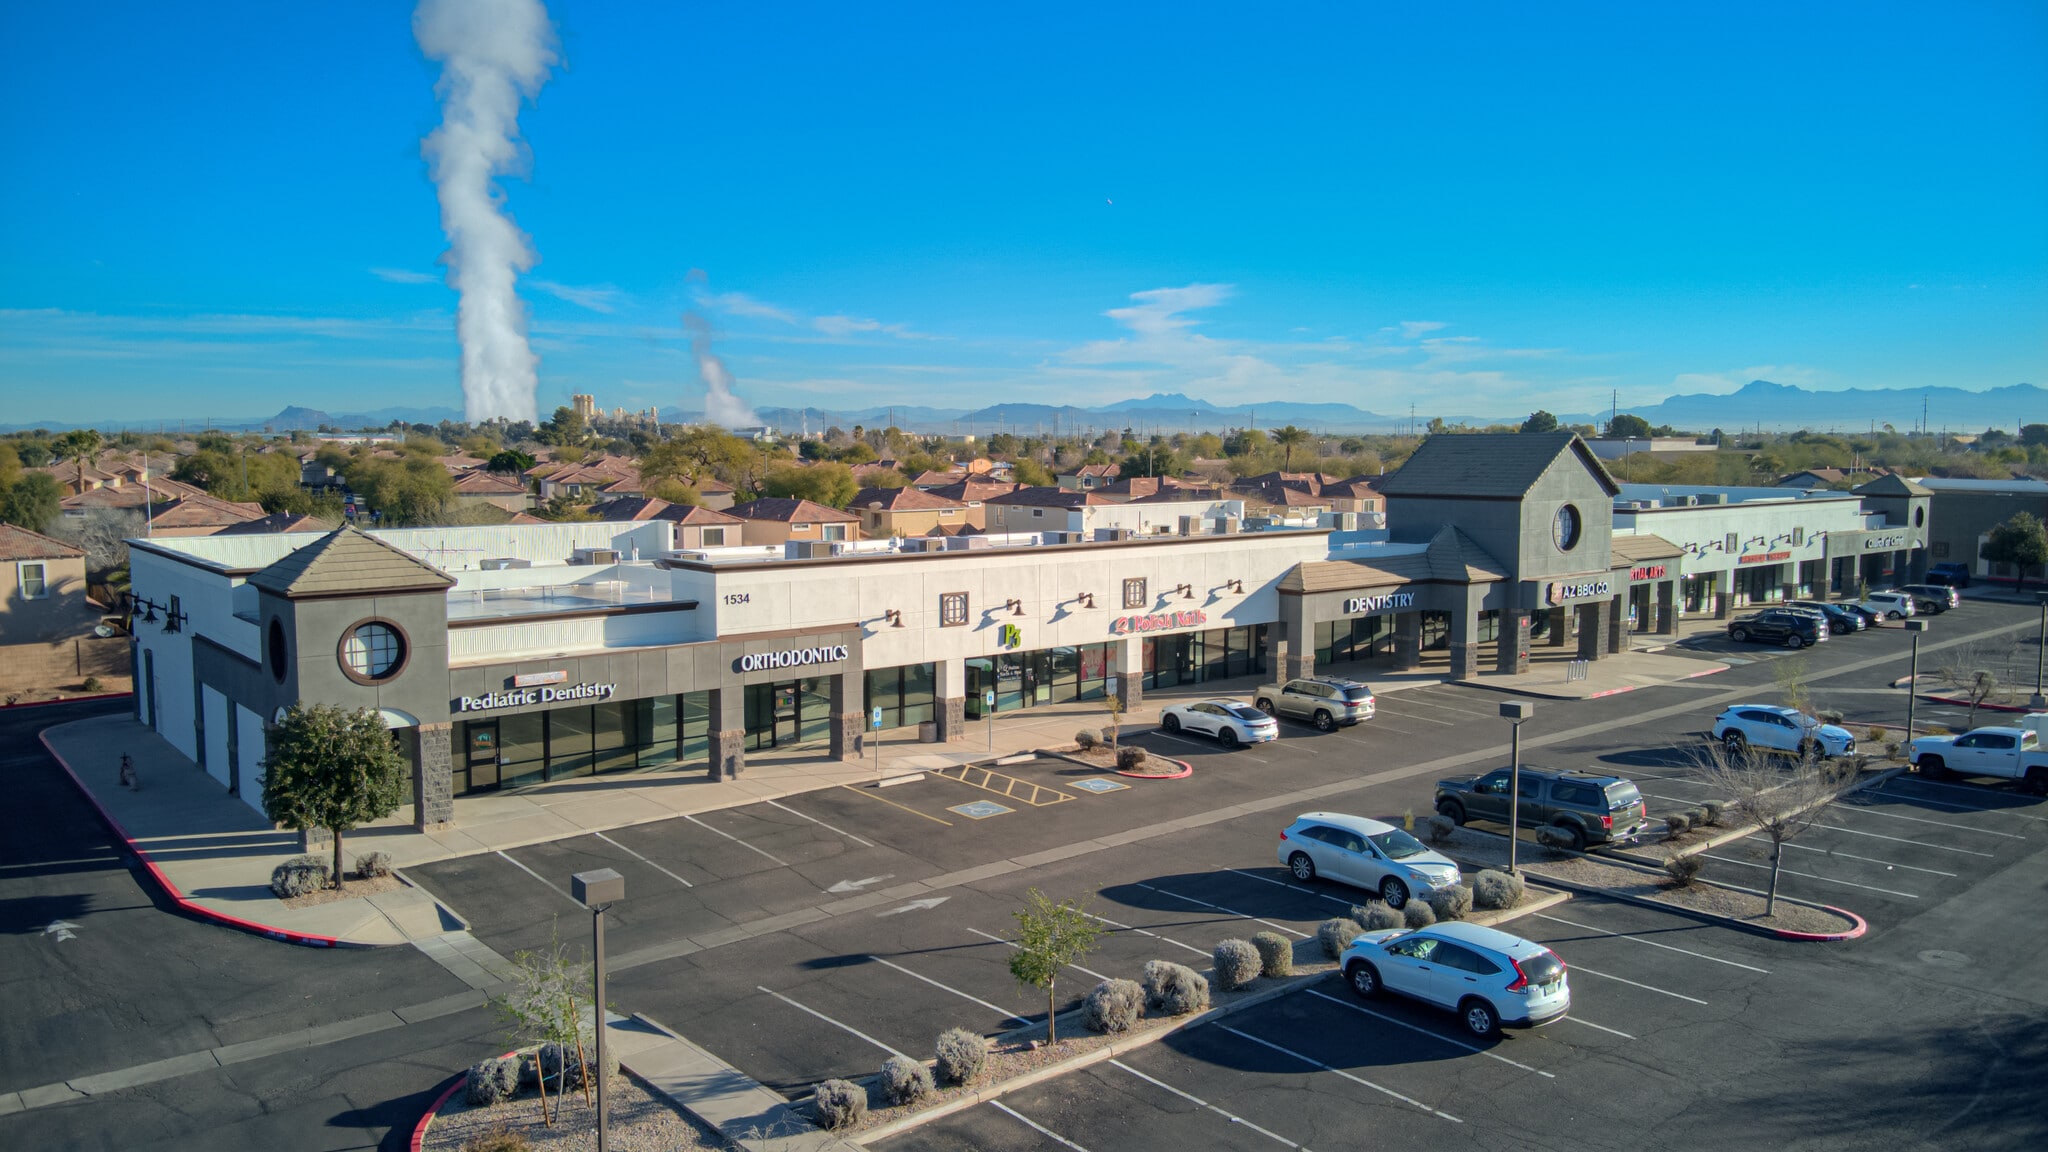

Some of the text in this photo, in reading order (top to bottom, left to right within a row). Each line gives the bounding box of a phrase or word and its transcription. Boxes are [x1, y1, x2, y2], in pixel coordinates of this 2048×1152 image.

[1630, 565, 1666, 580] RTIAL ARTS
[723, 593, 750, 605] 1534
[1563, 581, 1609, 599] AZ BBQ CO.
[1350, 592, 1415, 613] DENTISTRY
[1133, 613, 1173, 632] Polish
[1176, 609, 1207, 628] Nails
[741, 644, 849, 671] ORTHODONTICS
[461, 682, 617, 711] Pediatric Dentistry
